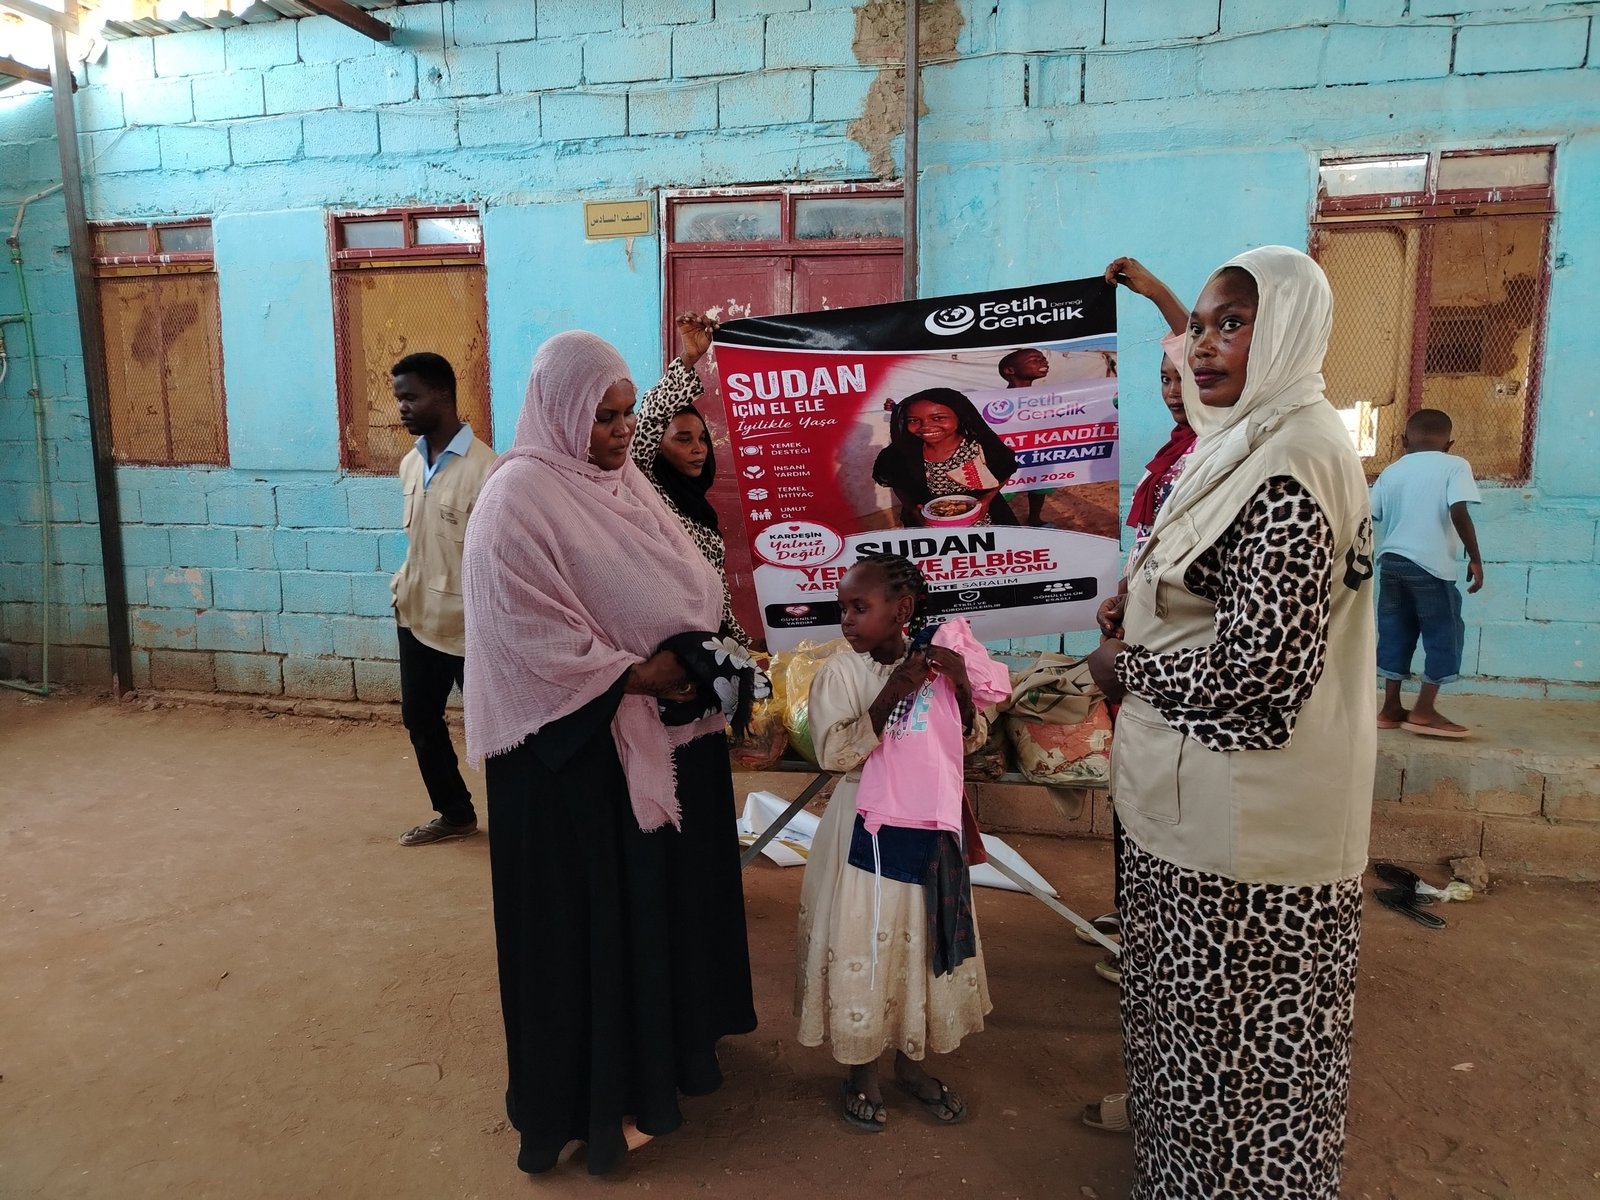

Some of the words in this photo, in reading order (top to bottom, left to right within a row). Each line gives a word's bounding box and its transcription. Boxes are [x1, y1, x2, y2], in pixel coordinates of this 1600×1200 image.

[590, 213, 619, 226] السادس
[621, 211, 646, 222] الصف
[979, 296, 1047, 317] Fetih
[979, 306, 1084, 331] Gençlik
[726, 363, 867, 402] SUDAN
[732, 402, 766, 418] İÇİN
[769, 401, 791, 415] EL
[795, 399, 826, 413] ELE
[1017, 392, 1063, 409] Fetih
[1017, 403, 1086, 422] Gençlik
[735, 418, 793, 436] İyilikle
[799, 416, 839, 429] Yaşa
[1034, 424, 1119, 445] KANDİLİ
[771, 447, 811, 456] DESTEĞİ
[1031, 445, 1106, 464] İKRAMI
[1040, 471, 1076, 482] 2026
[770, 540, 824, 551] Yalnız
[776, 546, 827, 561] Değil!
[855, 532, 996, 561] SUDAN
[952, 549, 1050, 571] ELBİSE
[796, 582, 839, 592] YAR
[962, 578, 1018, 588] SARALIM
